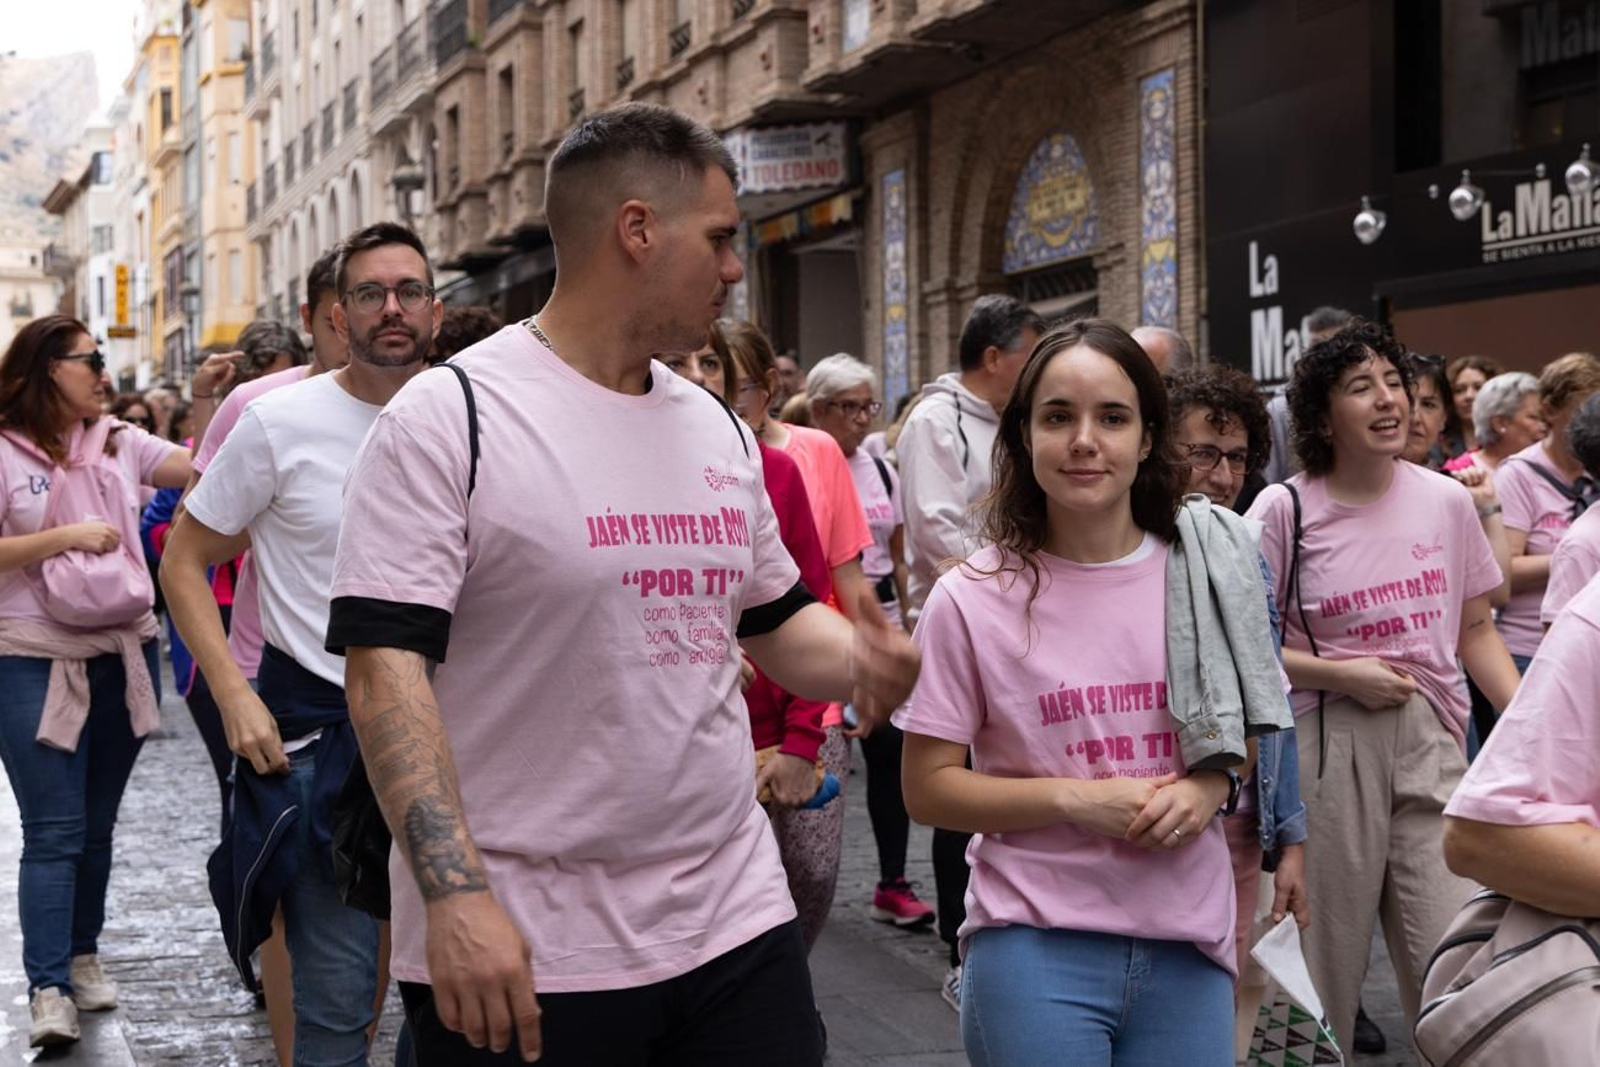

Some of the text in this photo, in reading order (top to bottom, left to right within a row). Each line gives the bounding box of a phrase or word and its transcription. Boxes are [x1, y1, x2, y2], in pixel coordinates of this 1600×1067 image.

[752, 157, 840, 185] TOLEDANO
[1248, 240, 1279, 297] La
[1250, 305, 1310, 381] Ma
[586, 507, 630, 548] JAÉN
[631, 513, 651, 545] SE
[651, 513, 700, 545] VISTE
[700, 514, 723, 545] DE
[622, 568, 694, 598] “POR
[1319, 590, 1351, 619] JAÉN
[1352, 589, 1369, 611] SE
[1368, 580, 1407, 607] VISTE
[1405, 577, 1423, 599] DE
[644, 606, 676, 621] como
[646, 628, 678, 645] como
[649, 651, 679, 667] como
[1038, 681, 1168, 727] JAÉN SE VISTE D
